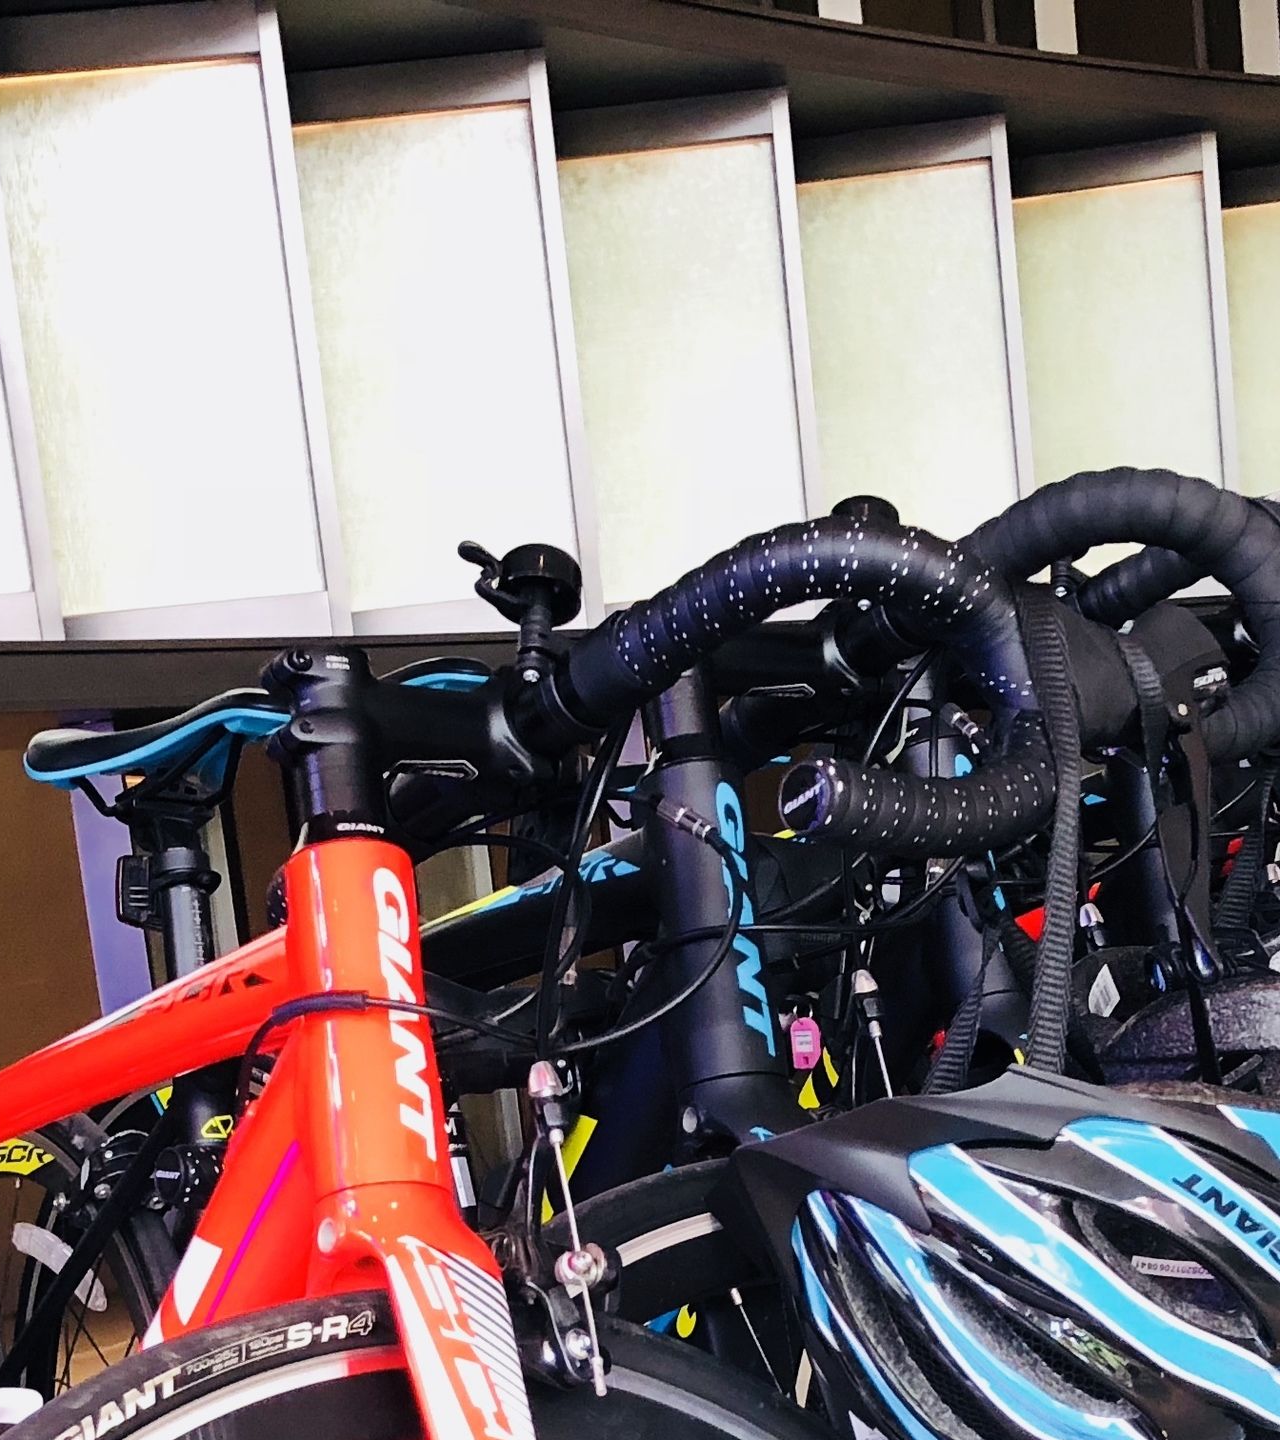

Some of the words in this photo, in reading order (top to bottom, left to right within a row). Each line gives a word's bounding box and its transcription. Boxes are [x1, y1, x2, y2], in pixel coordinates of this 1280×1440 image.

[782, 779, 826, 815] GIANT
[336, 822, 385, 834] GIANT
[372, 866, 437, 1162] GIANT
